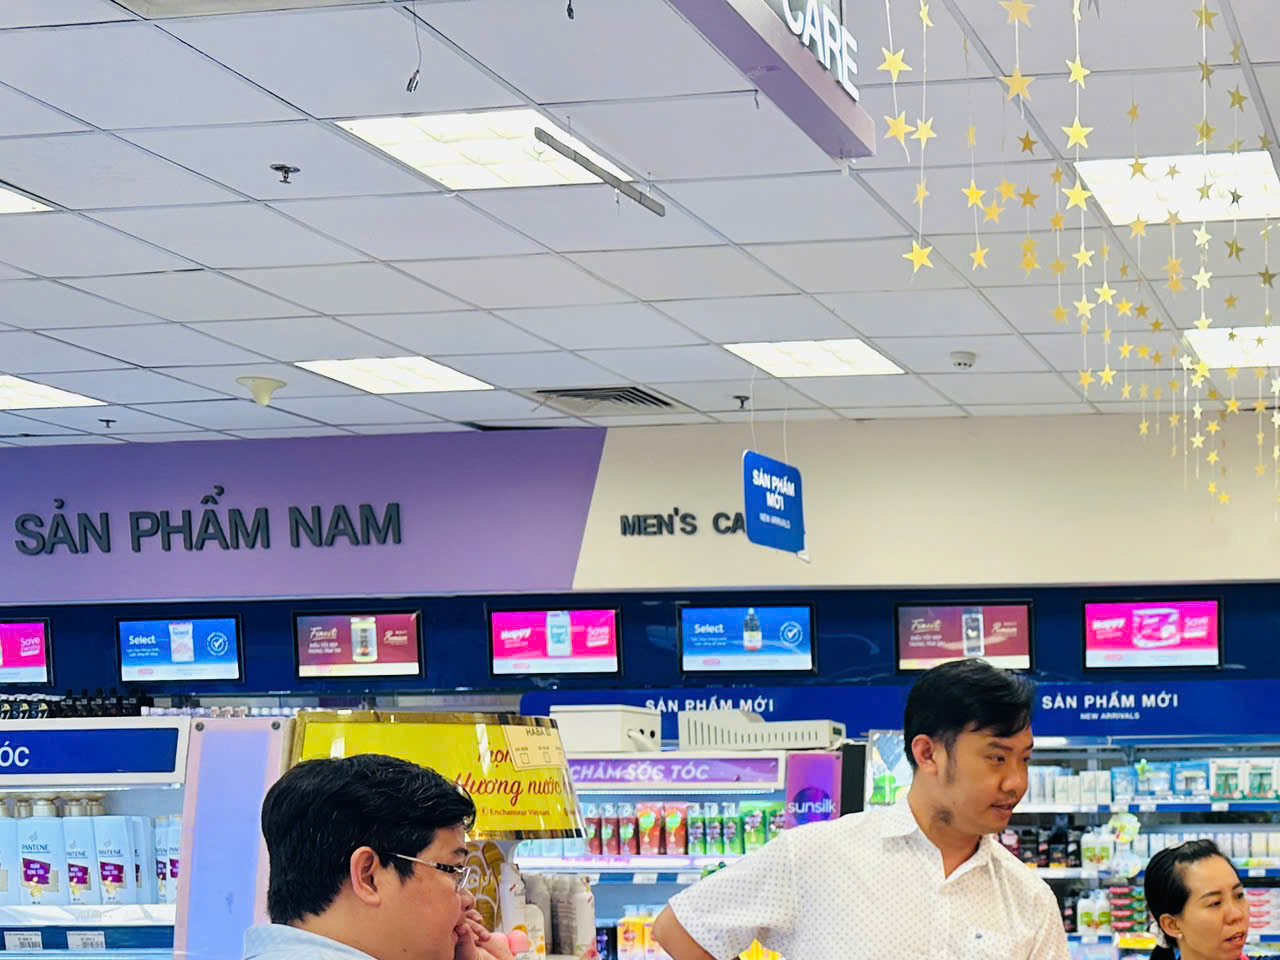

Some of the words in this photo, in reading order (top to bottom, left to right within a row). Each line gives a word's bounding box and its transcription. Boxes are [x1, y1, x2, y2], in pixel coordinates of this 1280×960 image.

[14, 498, 111, 555] SẢN
[129, 484, 271, 551] PHẨM
[289, 502, 402, 548] NAM
[620, 507, 698, 537] MEN'S
[712, 512, 746, 535] CA
[1042, 691, 1077, 710] SẢN
[1084, 690, 1135, 709] PHẨM
[1142, 691, 1178, 708] MỚI
[671, 764, 709, 780] TÓC
[788, 798, 836, 813] sunsilk
